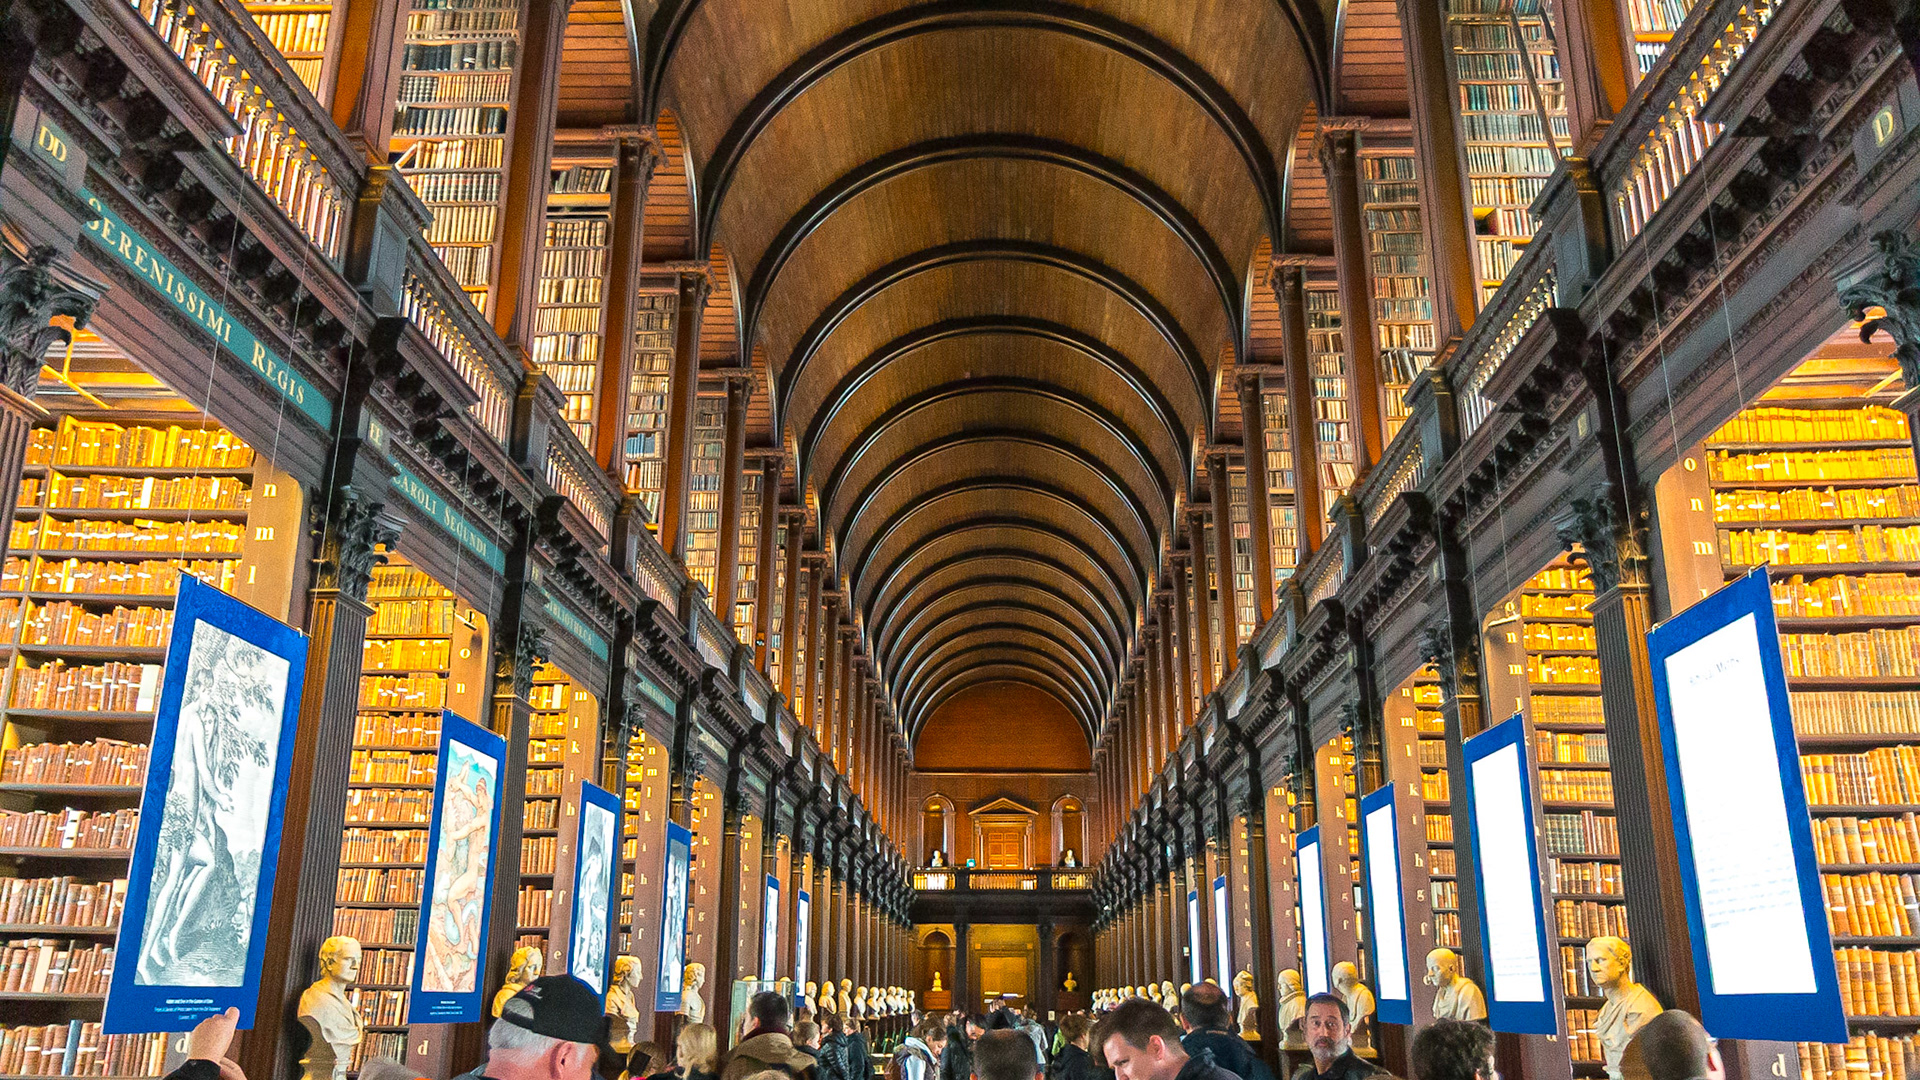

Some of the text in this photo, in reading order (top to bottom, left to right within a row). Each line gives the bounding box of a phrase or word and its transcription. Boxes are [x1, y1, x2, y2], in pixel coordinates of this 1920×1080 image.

[1875, 111, 1894, 143] D
[39, 126, 67, 162] DD
[251, 340, 305, 404] REGIS
[1684, 457, 1697, 472] o
[263, 484, 277, 498] n
[1690, 498, 1704, 512] n
[254, 527, 274, 541] m
[1693, 541, 1714, 555] m
[1504, 601, 1516, 612] o
[1506, 632, 1518, 643] n
[459, 648, 471, 659] o
[1508, 664, 1523, 675] m
[456, 682, 466, 694] n
[1401, 687, 1411, 697] n
[575, 692, 588, 701] m
[1400, 717, 1414, 727] m
[571, 741, 580, 754] k
[1329, 738, 1337, 746] n
[648, 747, 656, 755] n
[1329, 756, 1341, 765] m
[569, 770, 574, 783] i
[646, 768, 657, 777] m
[1274, 787, 1285, 796] m
[1409, 783, 1419, 796] k
[566, 802, 575, 816] h
[1335, 805, 1344, 818] k
[644, 810, 651, 822] k
[1412, 813, 1417, 825] i
[702, 836, 710, 846] k
[561, 844, 568, 856] g
[1414, 853, 1424, 867] h
[1339, 864, 1347, 875] h
[640, 873, 648, 885] h
[700, 885, 707, 895] h
[1283, 880, 1290, 891] h
[558, 890, 566, 905] f
[1341, 892, 1349, 902] g
[1416, 889, 1425, 902] g
[1421, 922, 1428, 936] f
[553, 950, 562, 960] e
[417, 1040, 429, 1056] d
[1771, 1053, 1787, 1077] d
